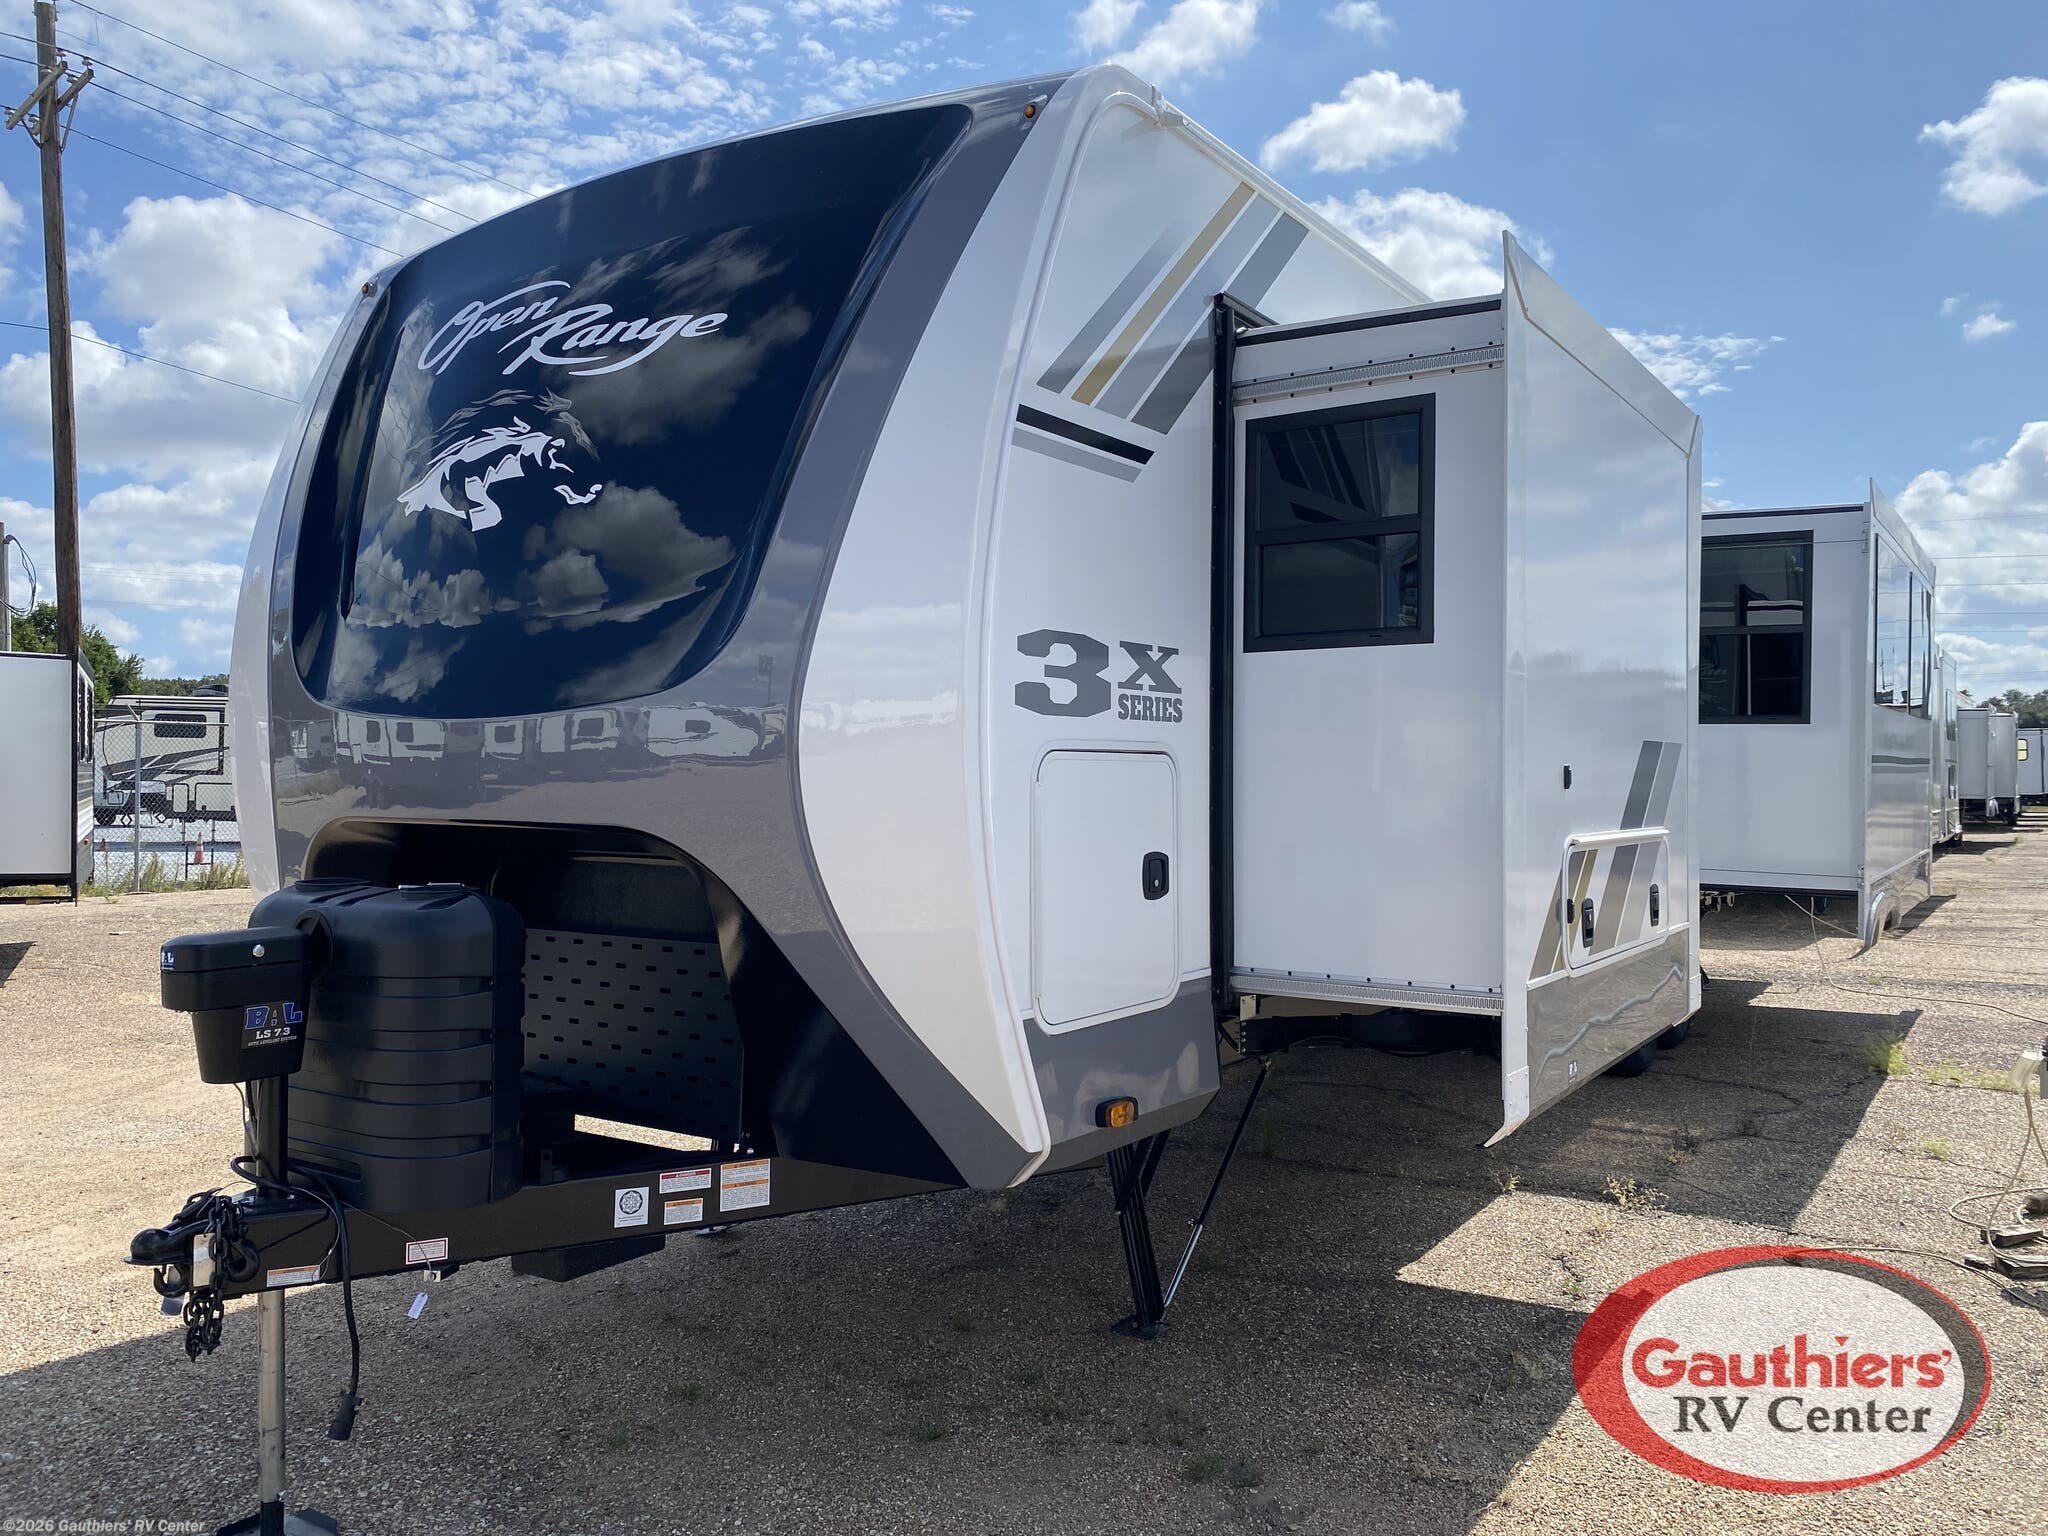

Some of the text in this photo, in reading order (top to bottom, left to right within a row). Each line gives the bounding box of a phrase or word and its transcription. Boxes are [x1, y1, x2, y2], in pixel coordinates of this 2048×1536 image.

[417, 280, 728, 376] Open Range
[1118, 694, 1183, 723] SERIES
[245, 1002, 303, 1030] BAL
[255, 1029, 272, 1040] LS
